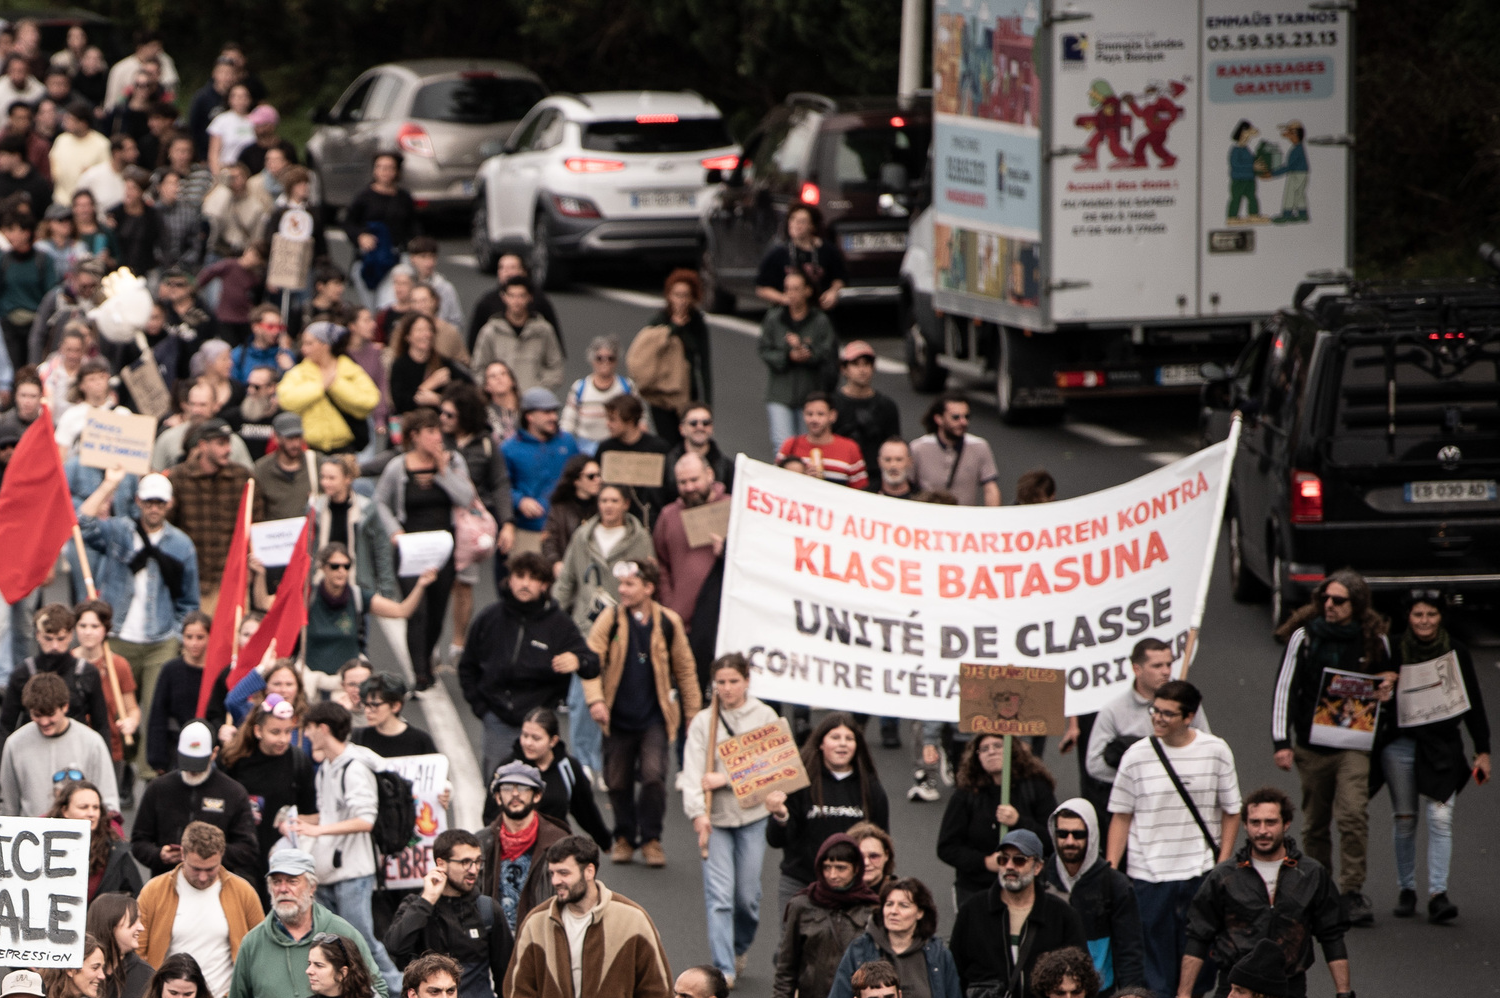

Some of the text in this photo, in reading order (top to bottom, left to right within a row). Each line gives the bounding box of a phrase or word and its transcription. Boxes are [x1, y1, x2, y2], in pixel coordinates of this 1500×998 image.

[1206, 10, 1340, 29] EMMAÜS TARNOS
[1207, 30, 1337, 51] 05.59.55.23.13
[1216, 61, 1326, 77] RAMASSAGES
[1233, 80, 1312, 95] GRATUITS
[747, 470, 1210, 553] ESTATU AUTORITARIOAREN KONTRA
[794, 529, 1169, 599] KLASE BATASUNA
[793, 587, 1172, 659] UNITÉ DE CLASSE
[750, 645, 961, 700] CONTRE L'ÉTA
